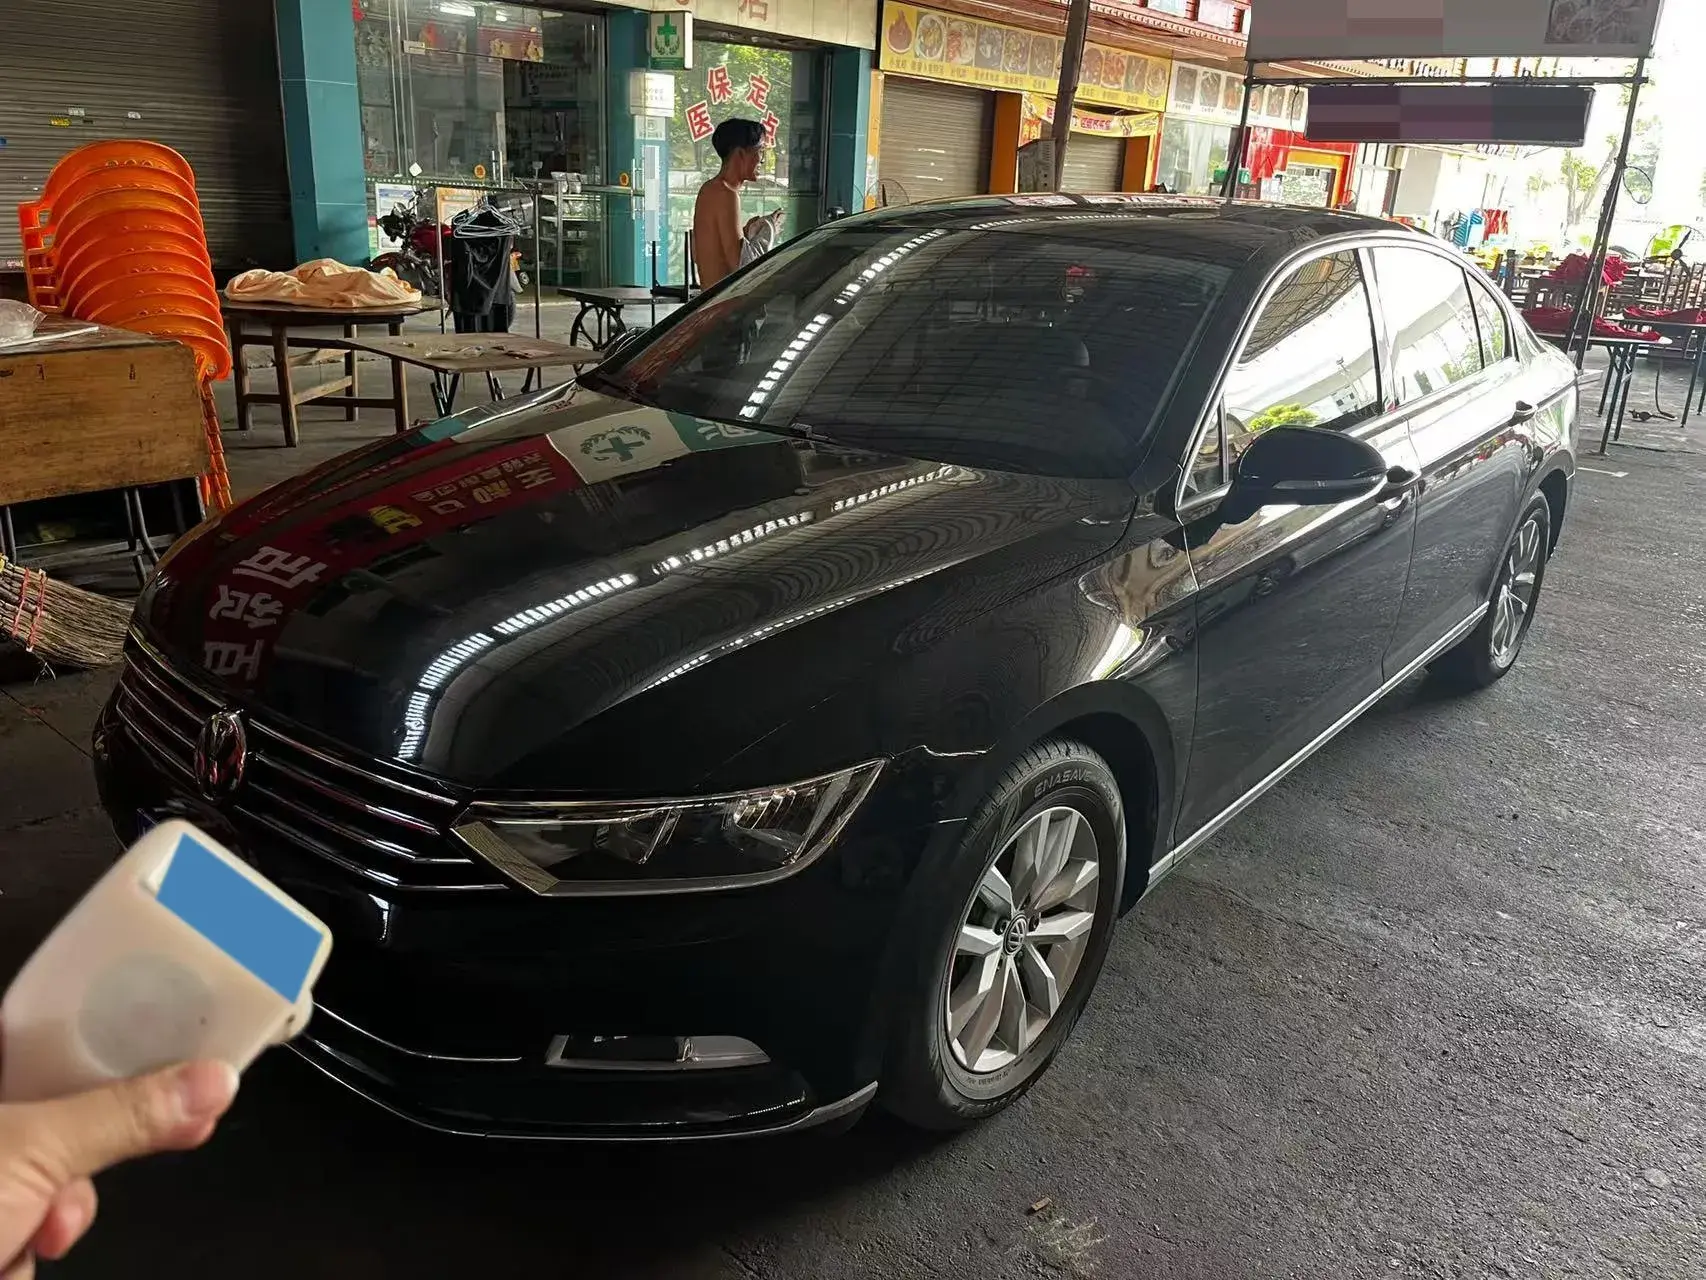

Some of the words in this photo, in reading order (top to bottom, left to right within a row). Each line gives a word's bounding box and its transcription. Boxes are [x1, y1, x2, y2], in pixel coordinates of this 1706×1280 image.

[685, 65, 779, 148] 医保定点
[1034, 768, 1092, 799] ENASAVE
